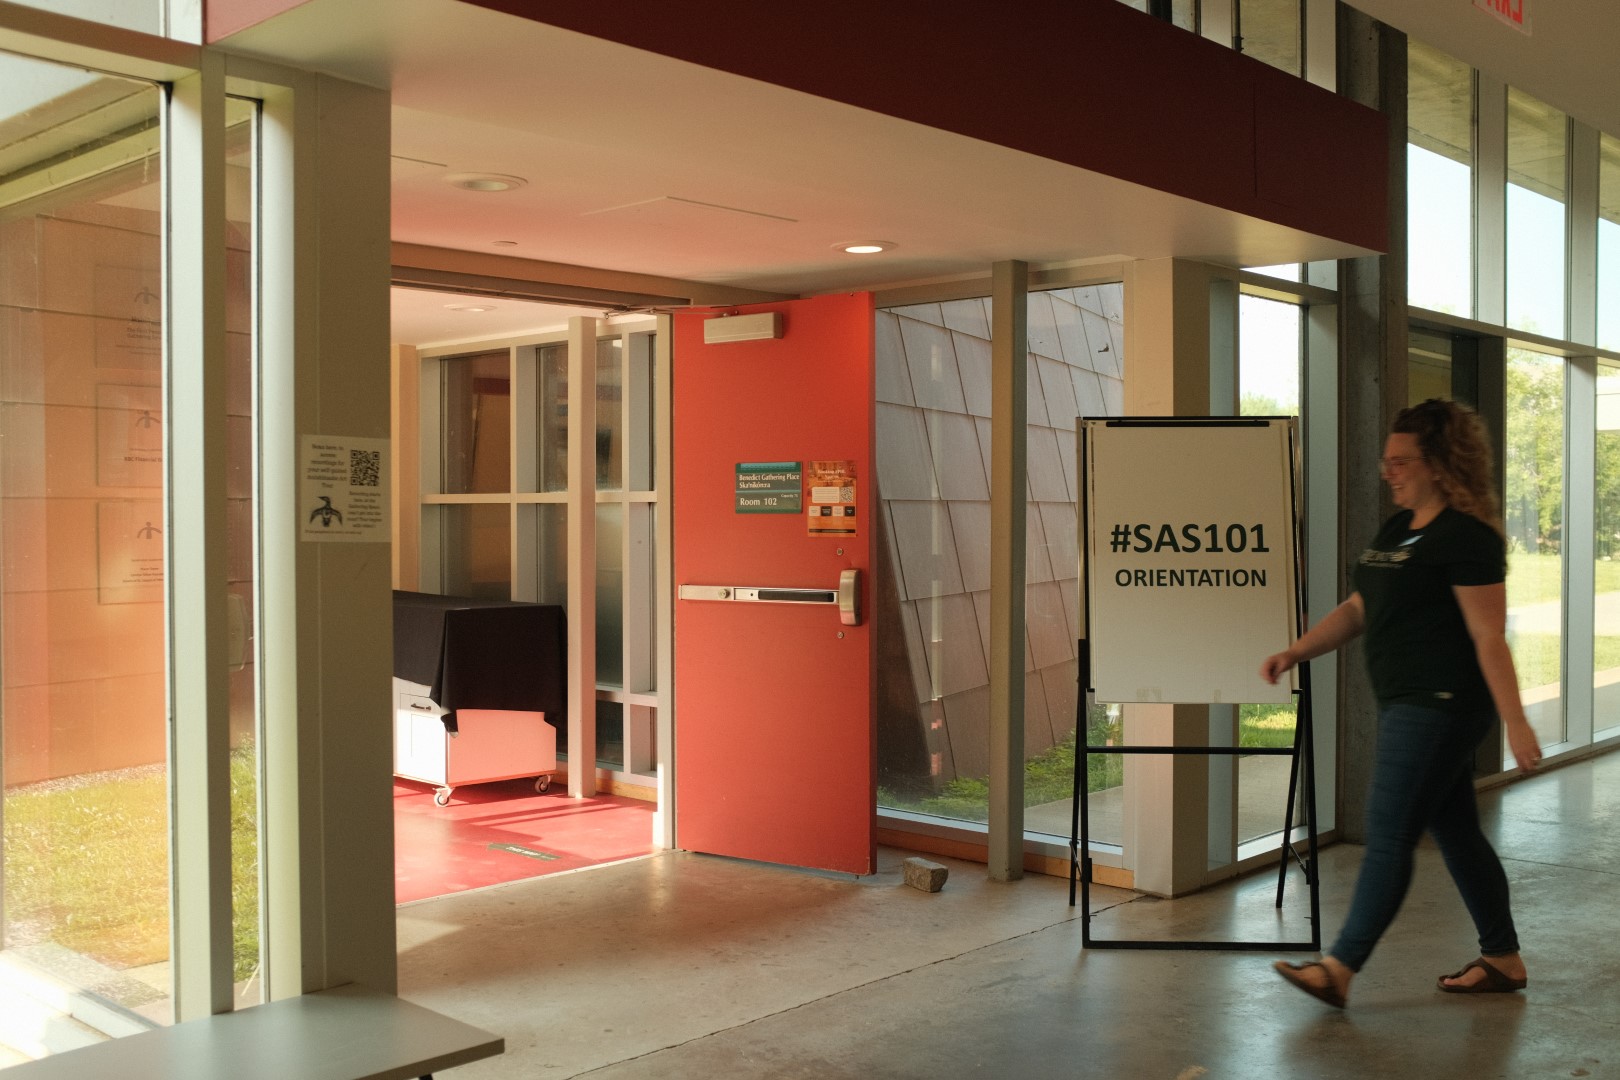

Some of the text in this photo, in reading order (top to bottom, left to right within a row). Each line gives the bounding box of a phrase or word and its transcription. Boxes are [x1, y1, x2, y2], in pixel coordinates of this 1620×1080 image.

[761, 473, 786, 482] Gathering
[740, 497, 777, 506] Room 102
[1110, 523, 1270, 553] #SAS101
[1115, 569, 1267, 587] ORIENTATION
